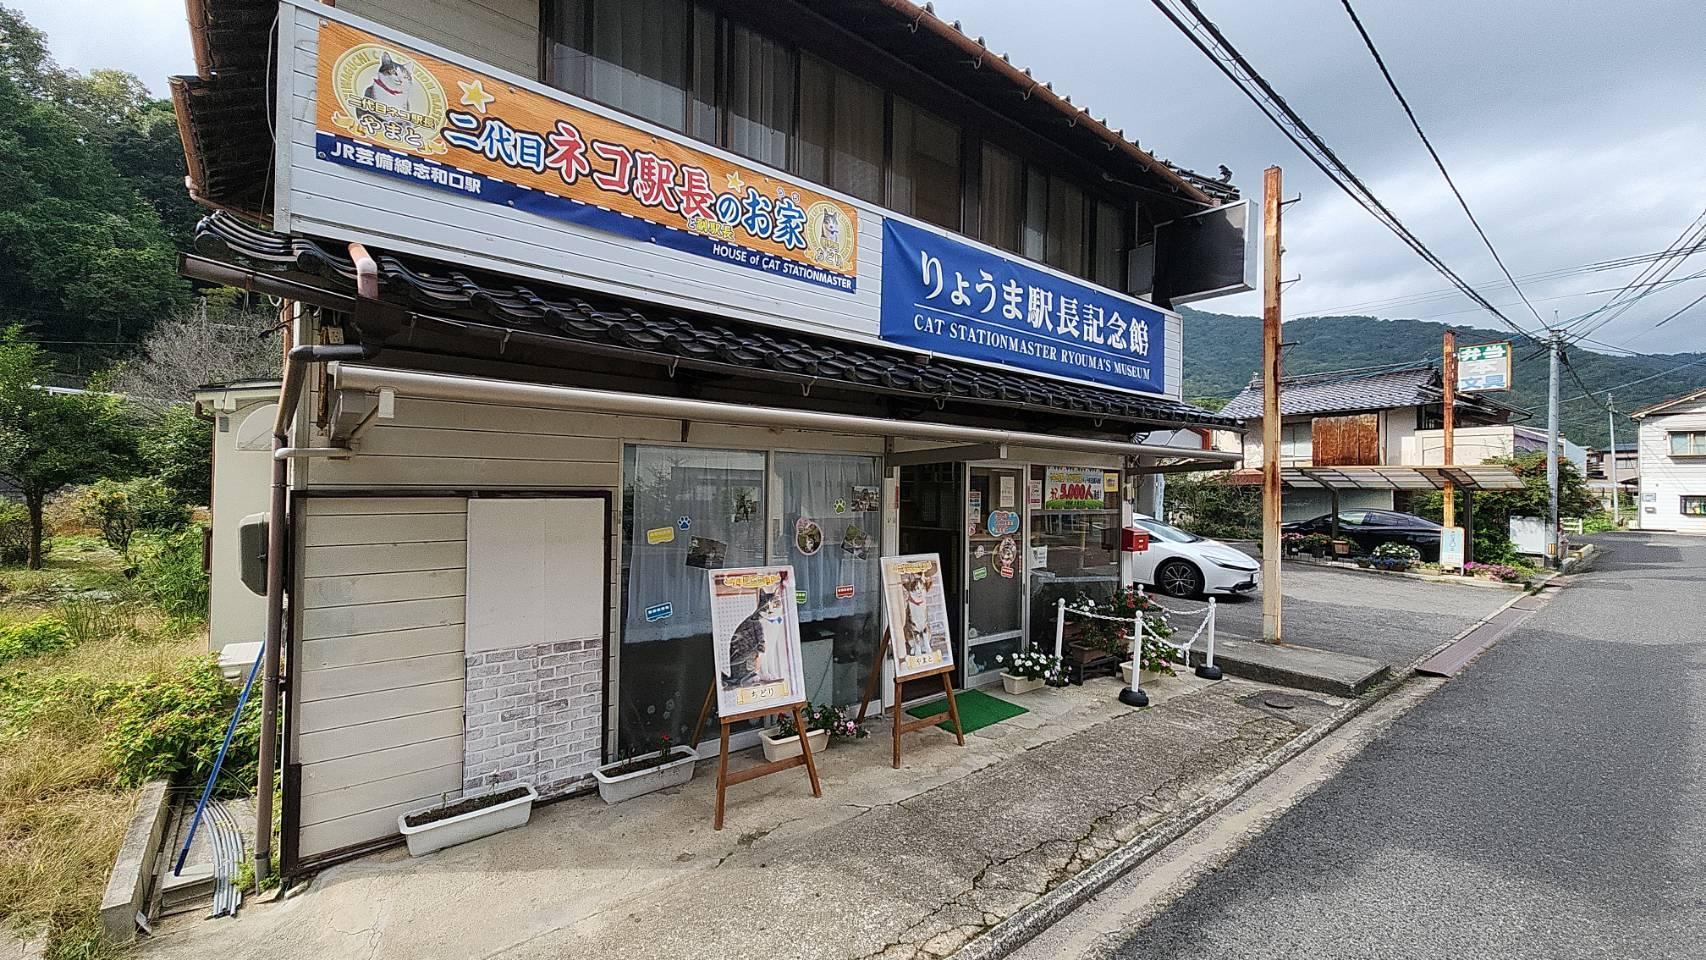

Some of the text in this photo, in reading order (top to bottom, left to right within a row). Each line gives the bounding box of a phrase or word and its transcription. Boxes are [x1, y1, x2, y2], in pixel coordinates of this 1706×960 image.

[360, 114, 424, 147] やまと
[331, 141, 482, 194] JR芸備線志和口駅
[713, 244, 852, 289] HOUSE of CAT STATIONMASTER
[920, 250, 1149, 357] りょうま駅長記念館
[914, 313, 1150, 381] CAT STATIONMASTER RYOUMA'S MUSEUM
[751, 689, 774, 698] ちどり
